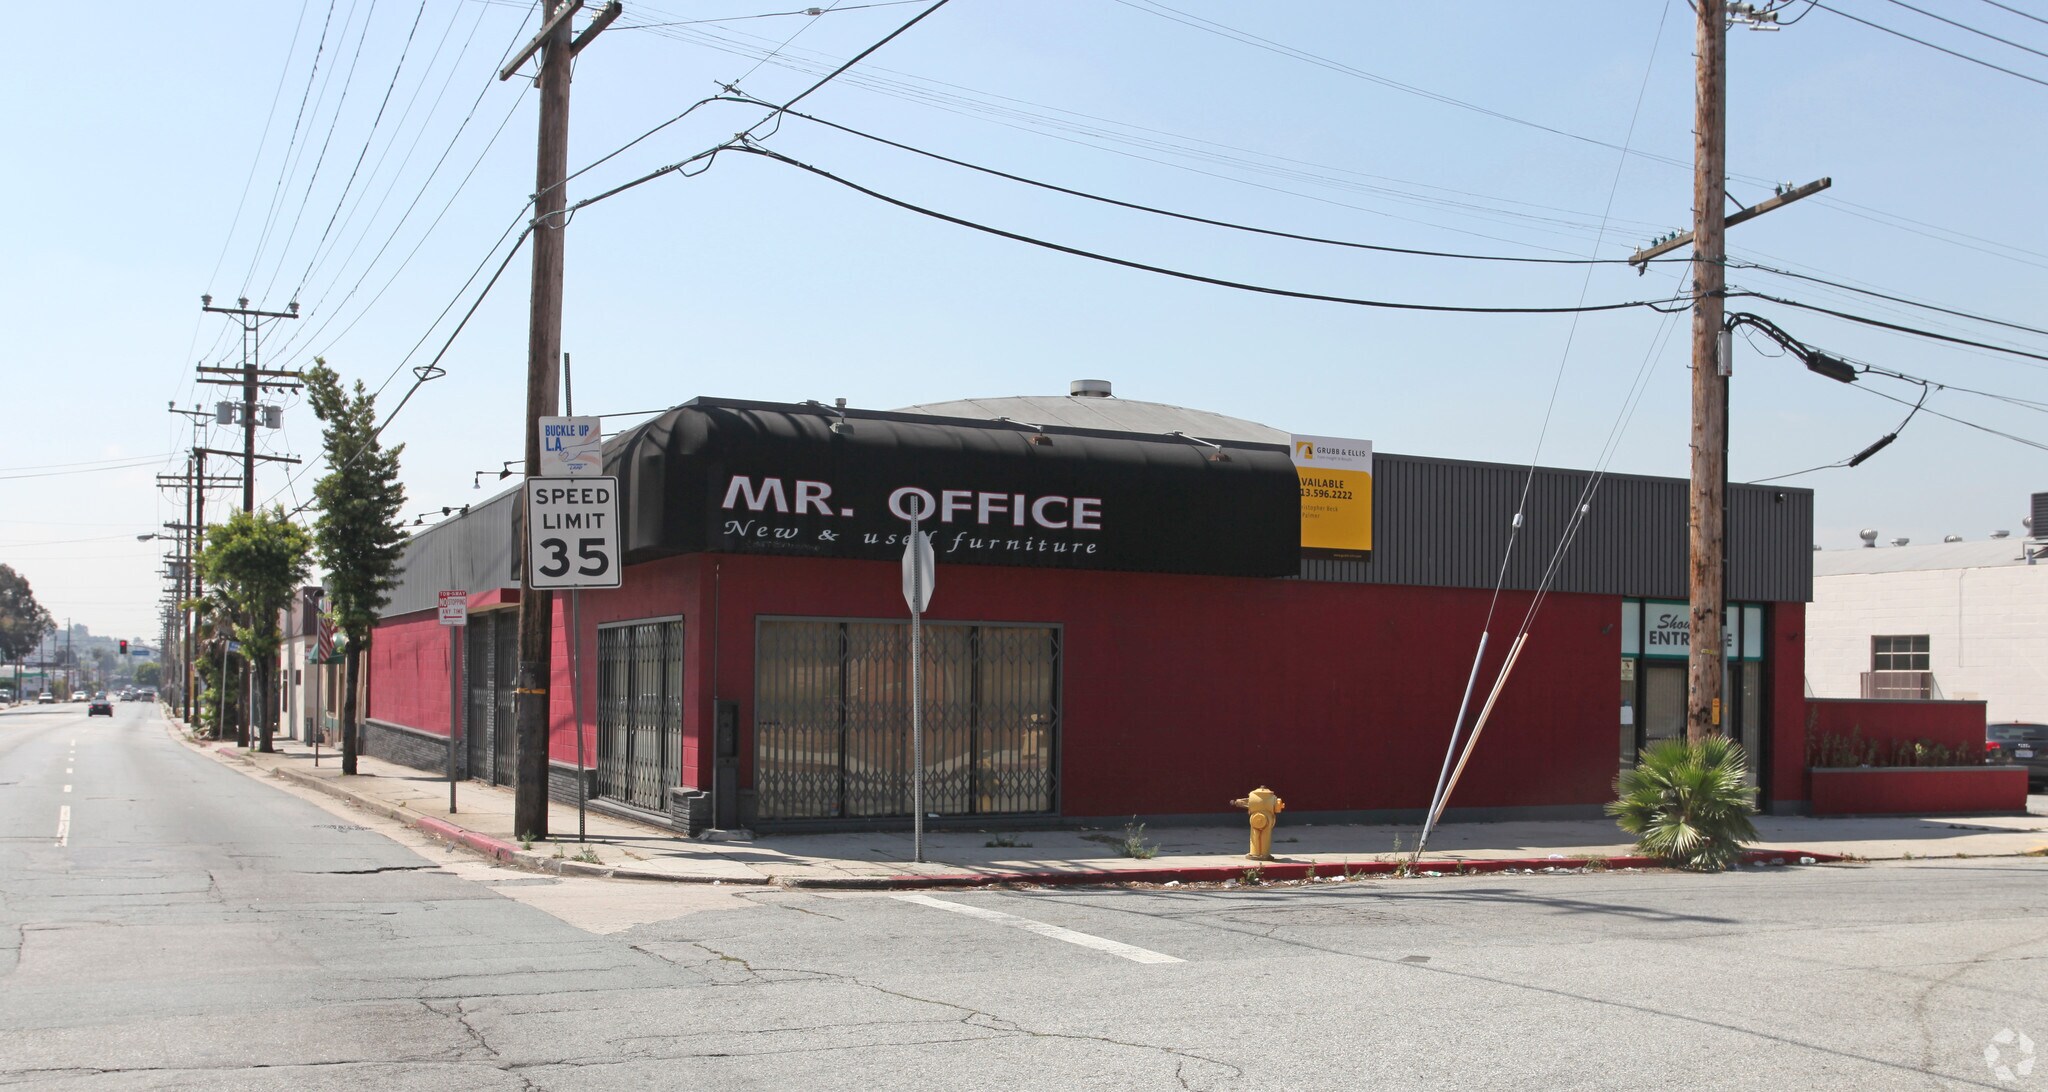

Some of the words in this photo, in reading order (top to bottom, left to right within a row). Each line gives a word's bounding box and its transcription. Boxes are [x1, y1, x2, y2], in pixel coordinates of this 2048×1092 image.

[545, 425, 575, 437] BUCKLE
[579, 425, 590, 437] UP
[1316, 446, 1340, 455] GRUBB
[1341, 448, 1347, 456] &
[1347, 449, 1366, 457] ELLIS
[1300, 477, 1344, 489] VAILABLE
[535, 488, 610, 505] SPEED
[1300, 488, 1353, 500] 13.596.2222
[721, 475, 854, 517] MR.
[887, 486, 1102, 530] OFFICE
[543, 513, 605, 530] LIMIT
[723, 519, 799, 539] New
[817, 529, 840, 542] &
[946, 531, 1097, 554] furniture
[538, 537, 610, 578] 35
[439, 597, 448, 607] NO
